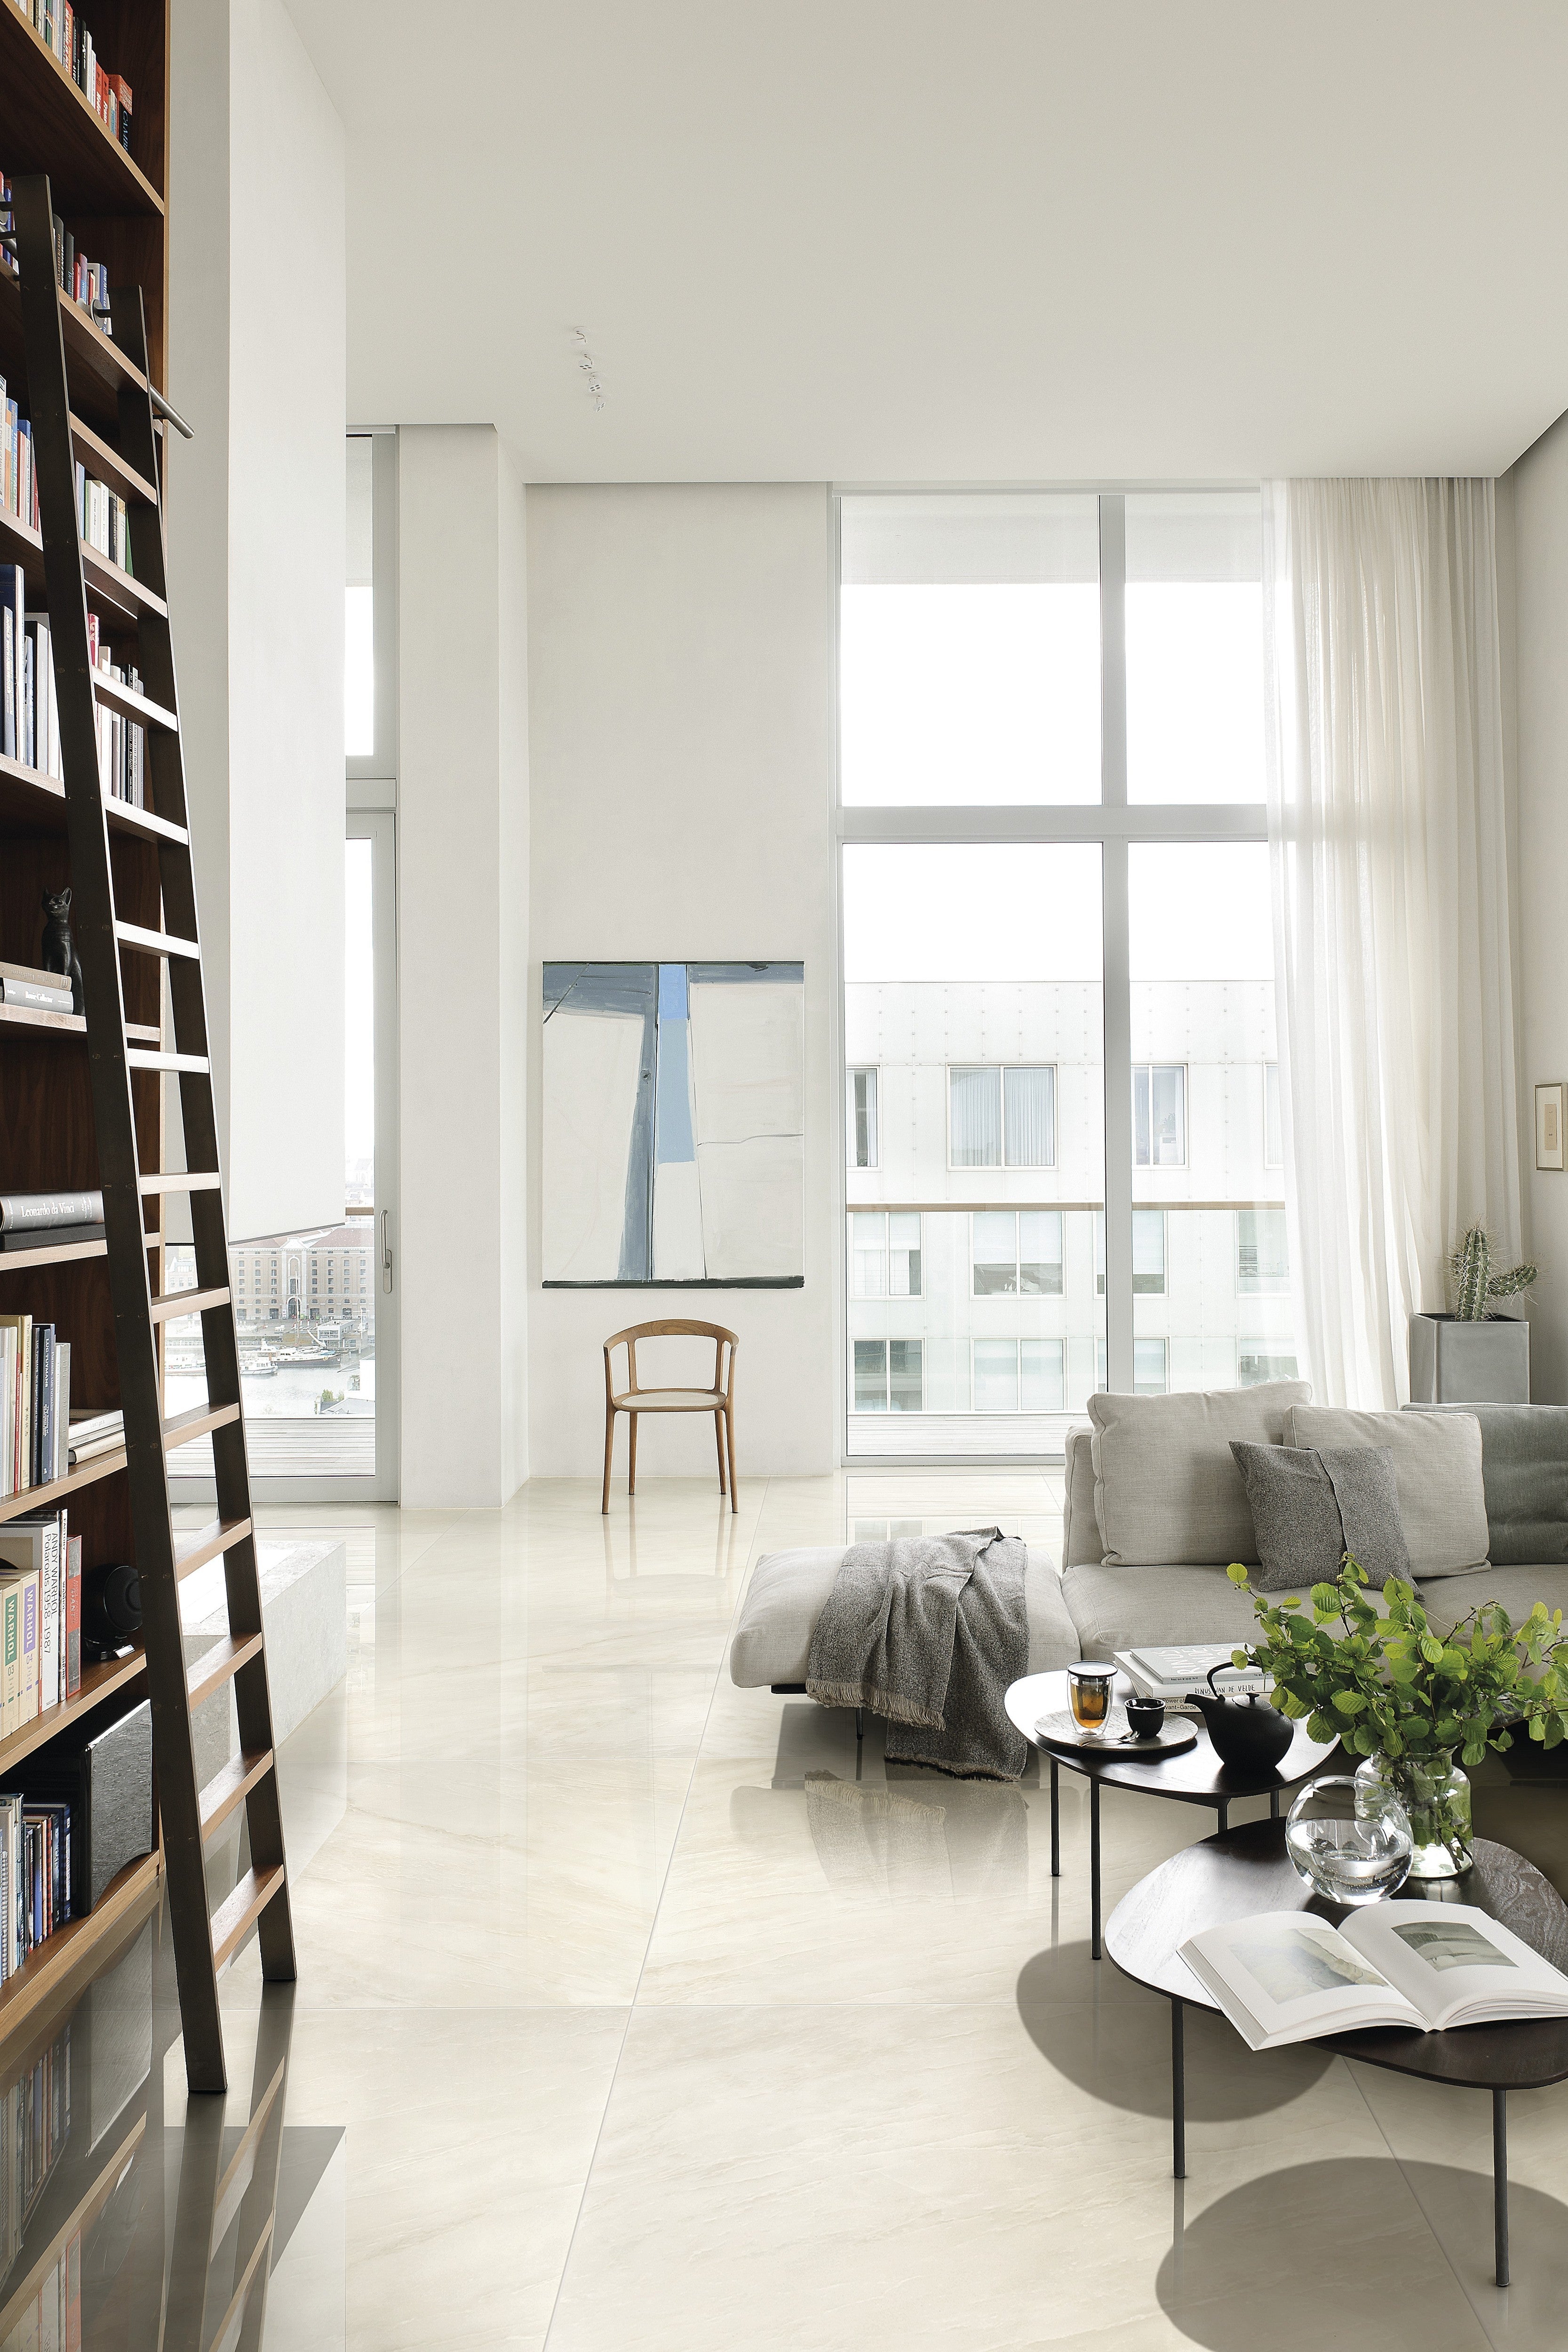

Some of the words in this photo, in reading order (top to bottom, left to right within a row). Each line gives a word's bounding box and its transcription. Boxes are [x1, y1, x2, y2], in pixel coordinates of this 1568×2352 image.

[20, 1202, 50, 1217] Leonardo
[51, 1202, 59, 1215] da
[58, 1201, 75, 1214] Vinci
[26, 1653, 33, 1665] 04
[1152, 1649, 1205, 1675] RINUS
[8, 1666, 14, 1677] 03
